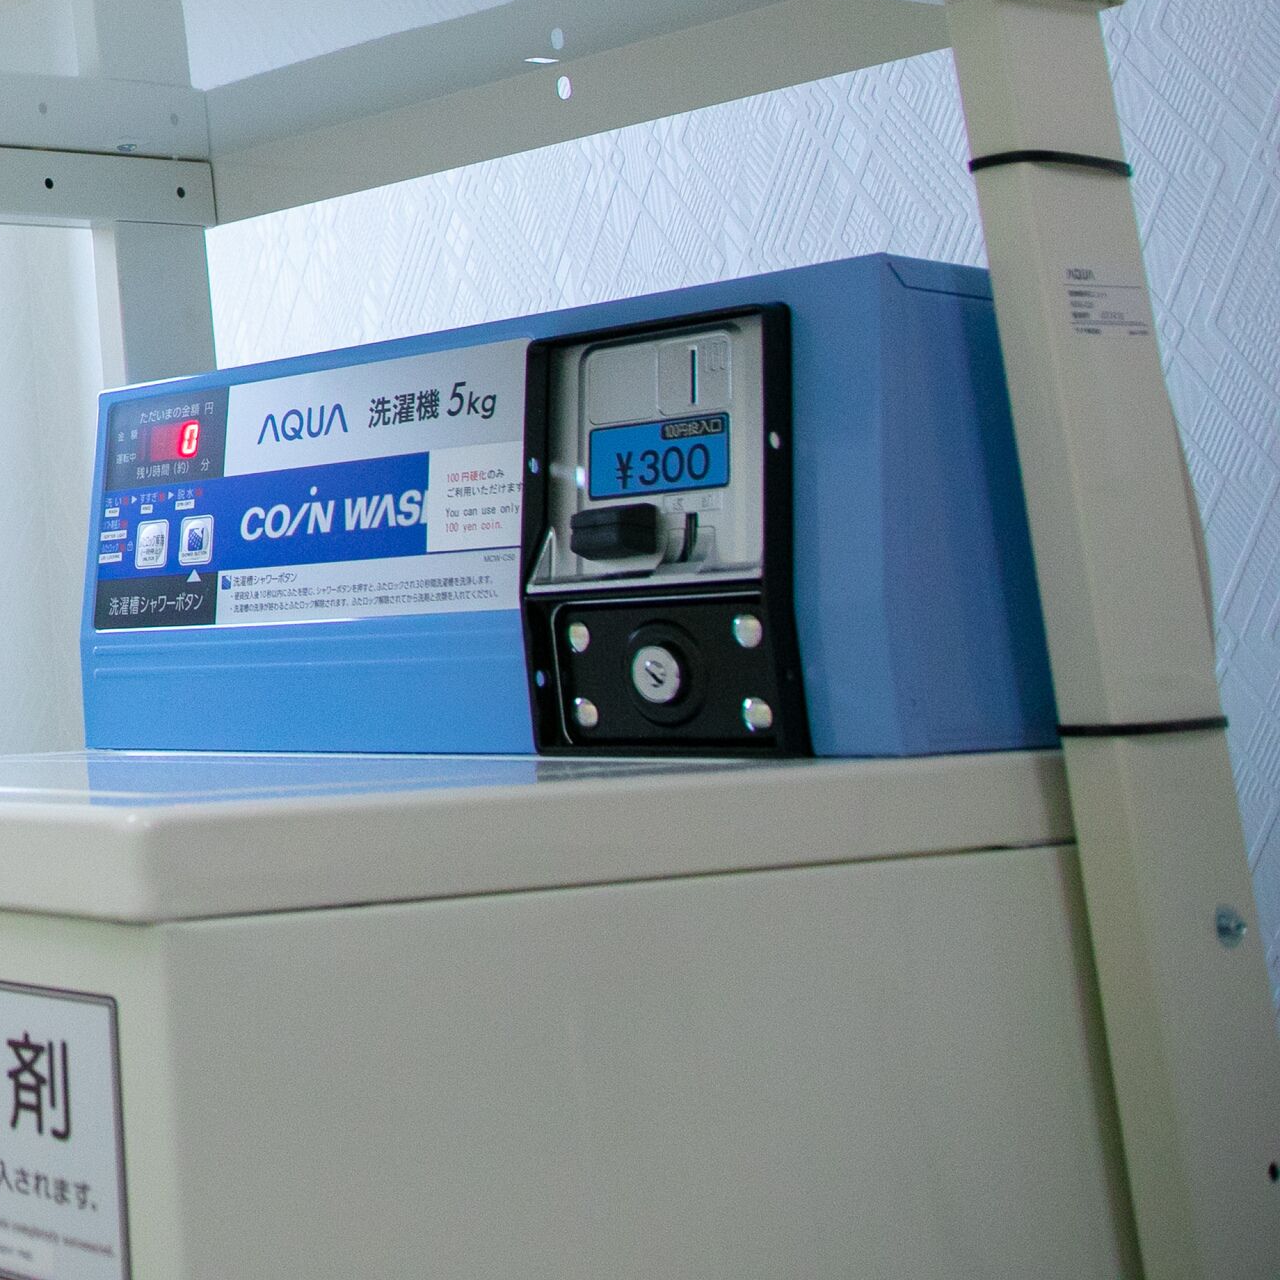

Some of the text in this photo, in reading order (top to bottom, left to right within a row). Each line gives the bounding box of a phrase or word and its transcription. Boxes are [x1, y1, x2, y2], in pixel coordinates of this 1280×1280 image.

[140, 401, 214, 424] ただいまの金額 円
[368, 381, 497, 428] 洗濯機 5kg
[257, 403, 348, 445] AQUA
[181, 423, 198, 455] 0
[116, 453, 136, 465] 運転中
[200, 458, 211, 472] 分
[616, 443, 709, 489] ¥300
[447, 482, 522, 498] ご利用いただけます
[240, 486, 335, 541] COIN
[445, 502, 520, 518] You can use only
[445, 522, 459, 533] 100
[463, 522, 477, 532] yen
[109, 592, 204, 616] 洗濯槽シャワーボタン
